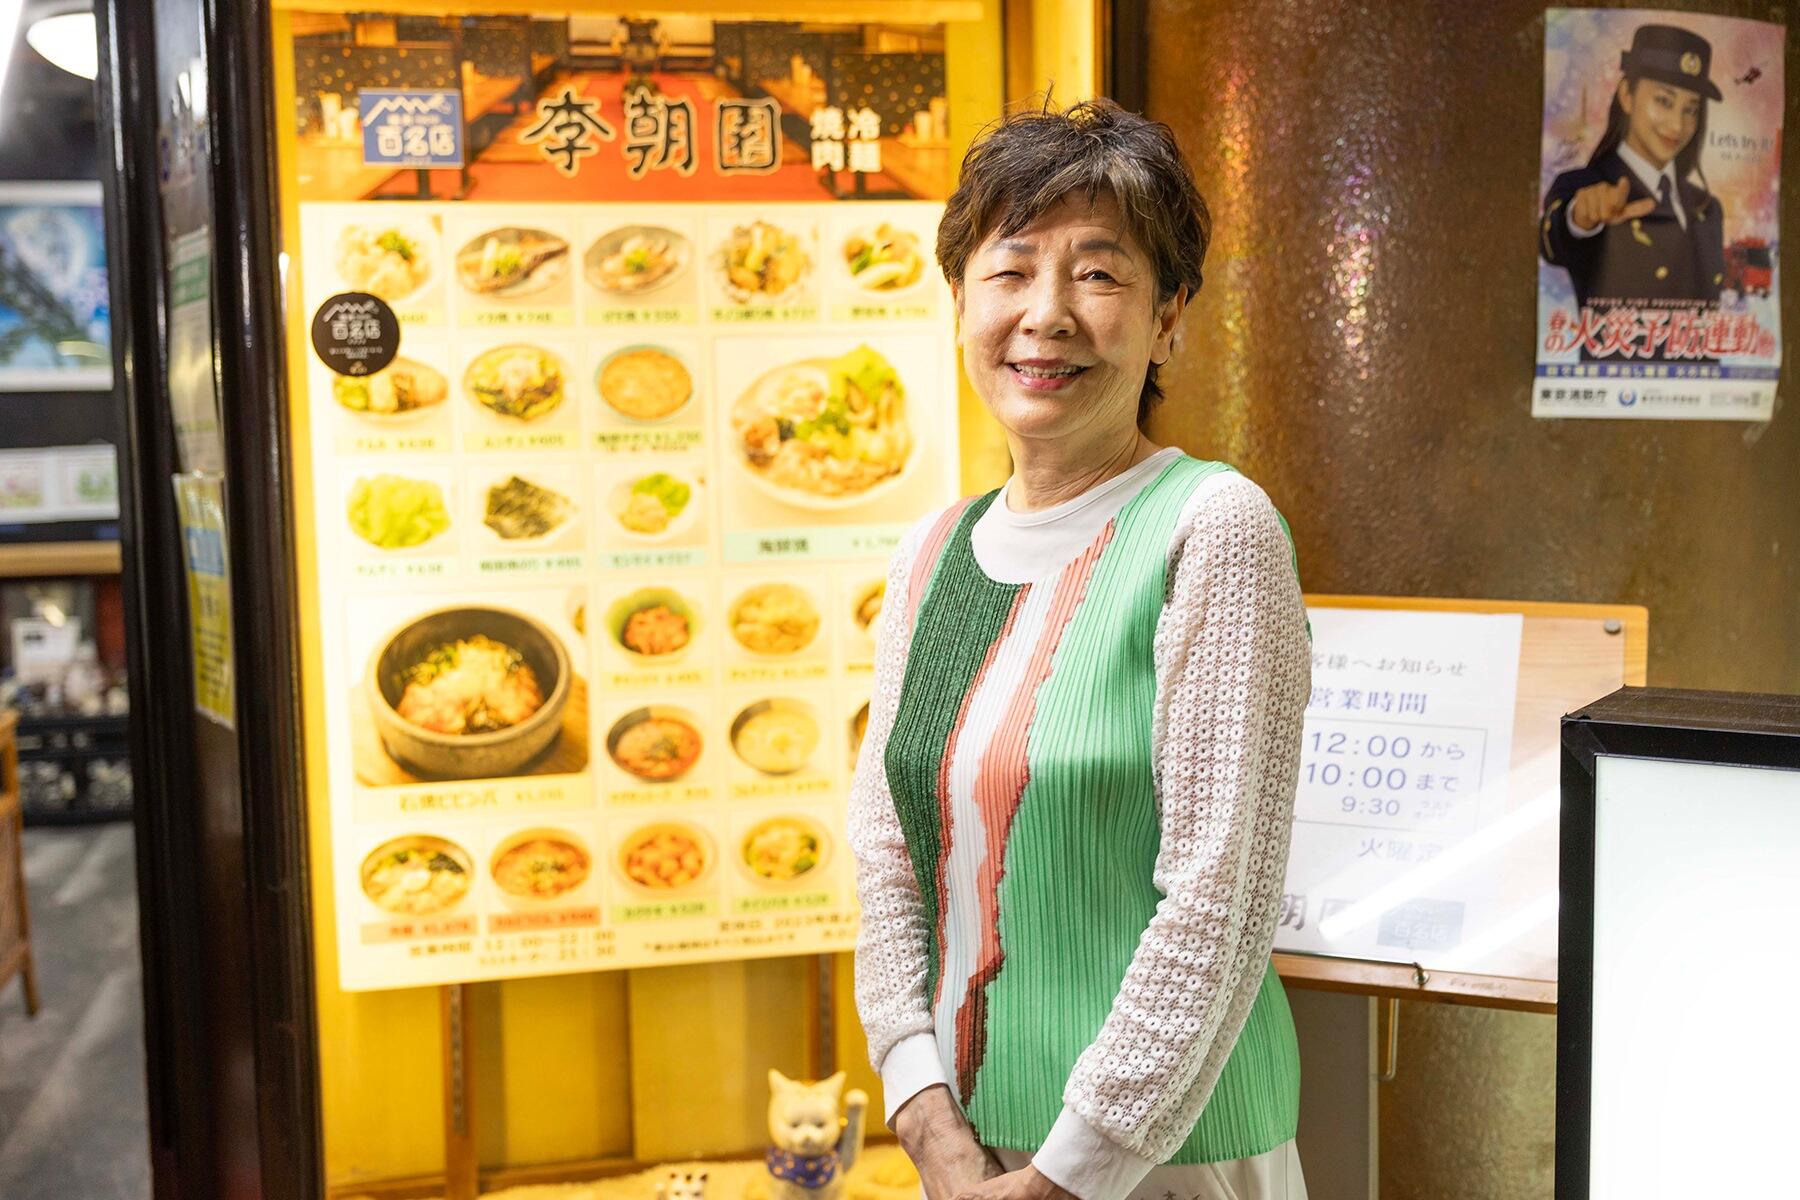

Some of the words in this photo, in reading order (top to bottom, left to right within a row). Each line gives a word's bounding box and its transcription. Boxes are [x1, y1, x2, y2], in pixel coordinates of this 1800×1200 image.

[375, 123, 456, 157] 百名店
[522, 87, 783, 178] 李朝園
[331, 318, 381, 340] 百名店
[1566, 306, 1761, 361] 火災予防運動
[1309, 686, 1428, 714] 営業時間
[1311, 731, 1412, 759] 12:00
[1419, 742, 1466, 761] から
[1305, 762, 1408, 791] 10:00
[1416, 773, 1461, 793] まで
[1341, 795, 1401, 817] 9:30
